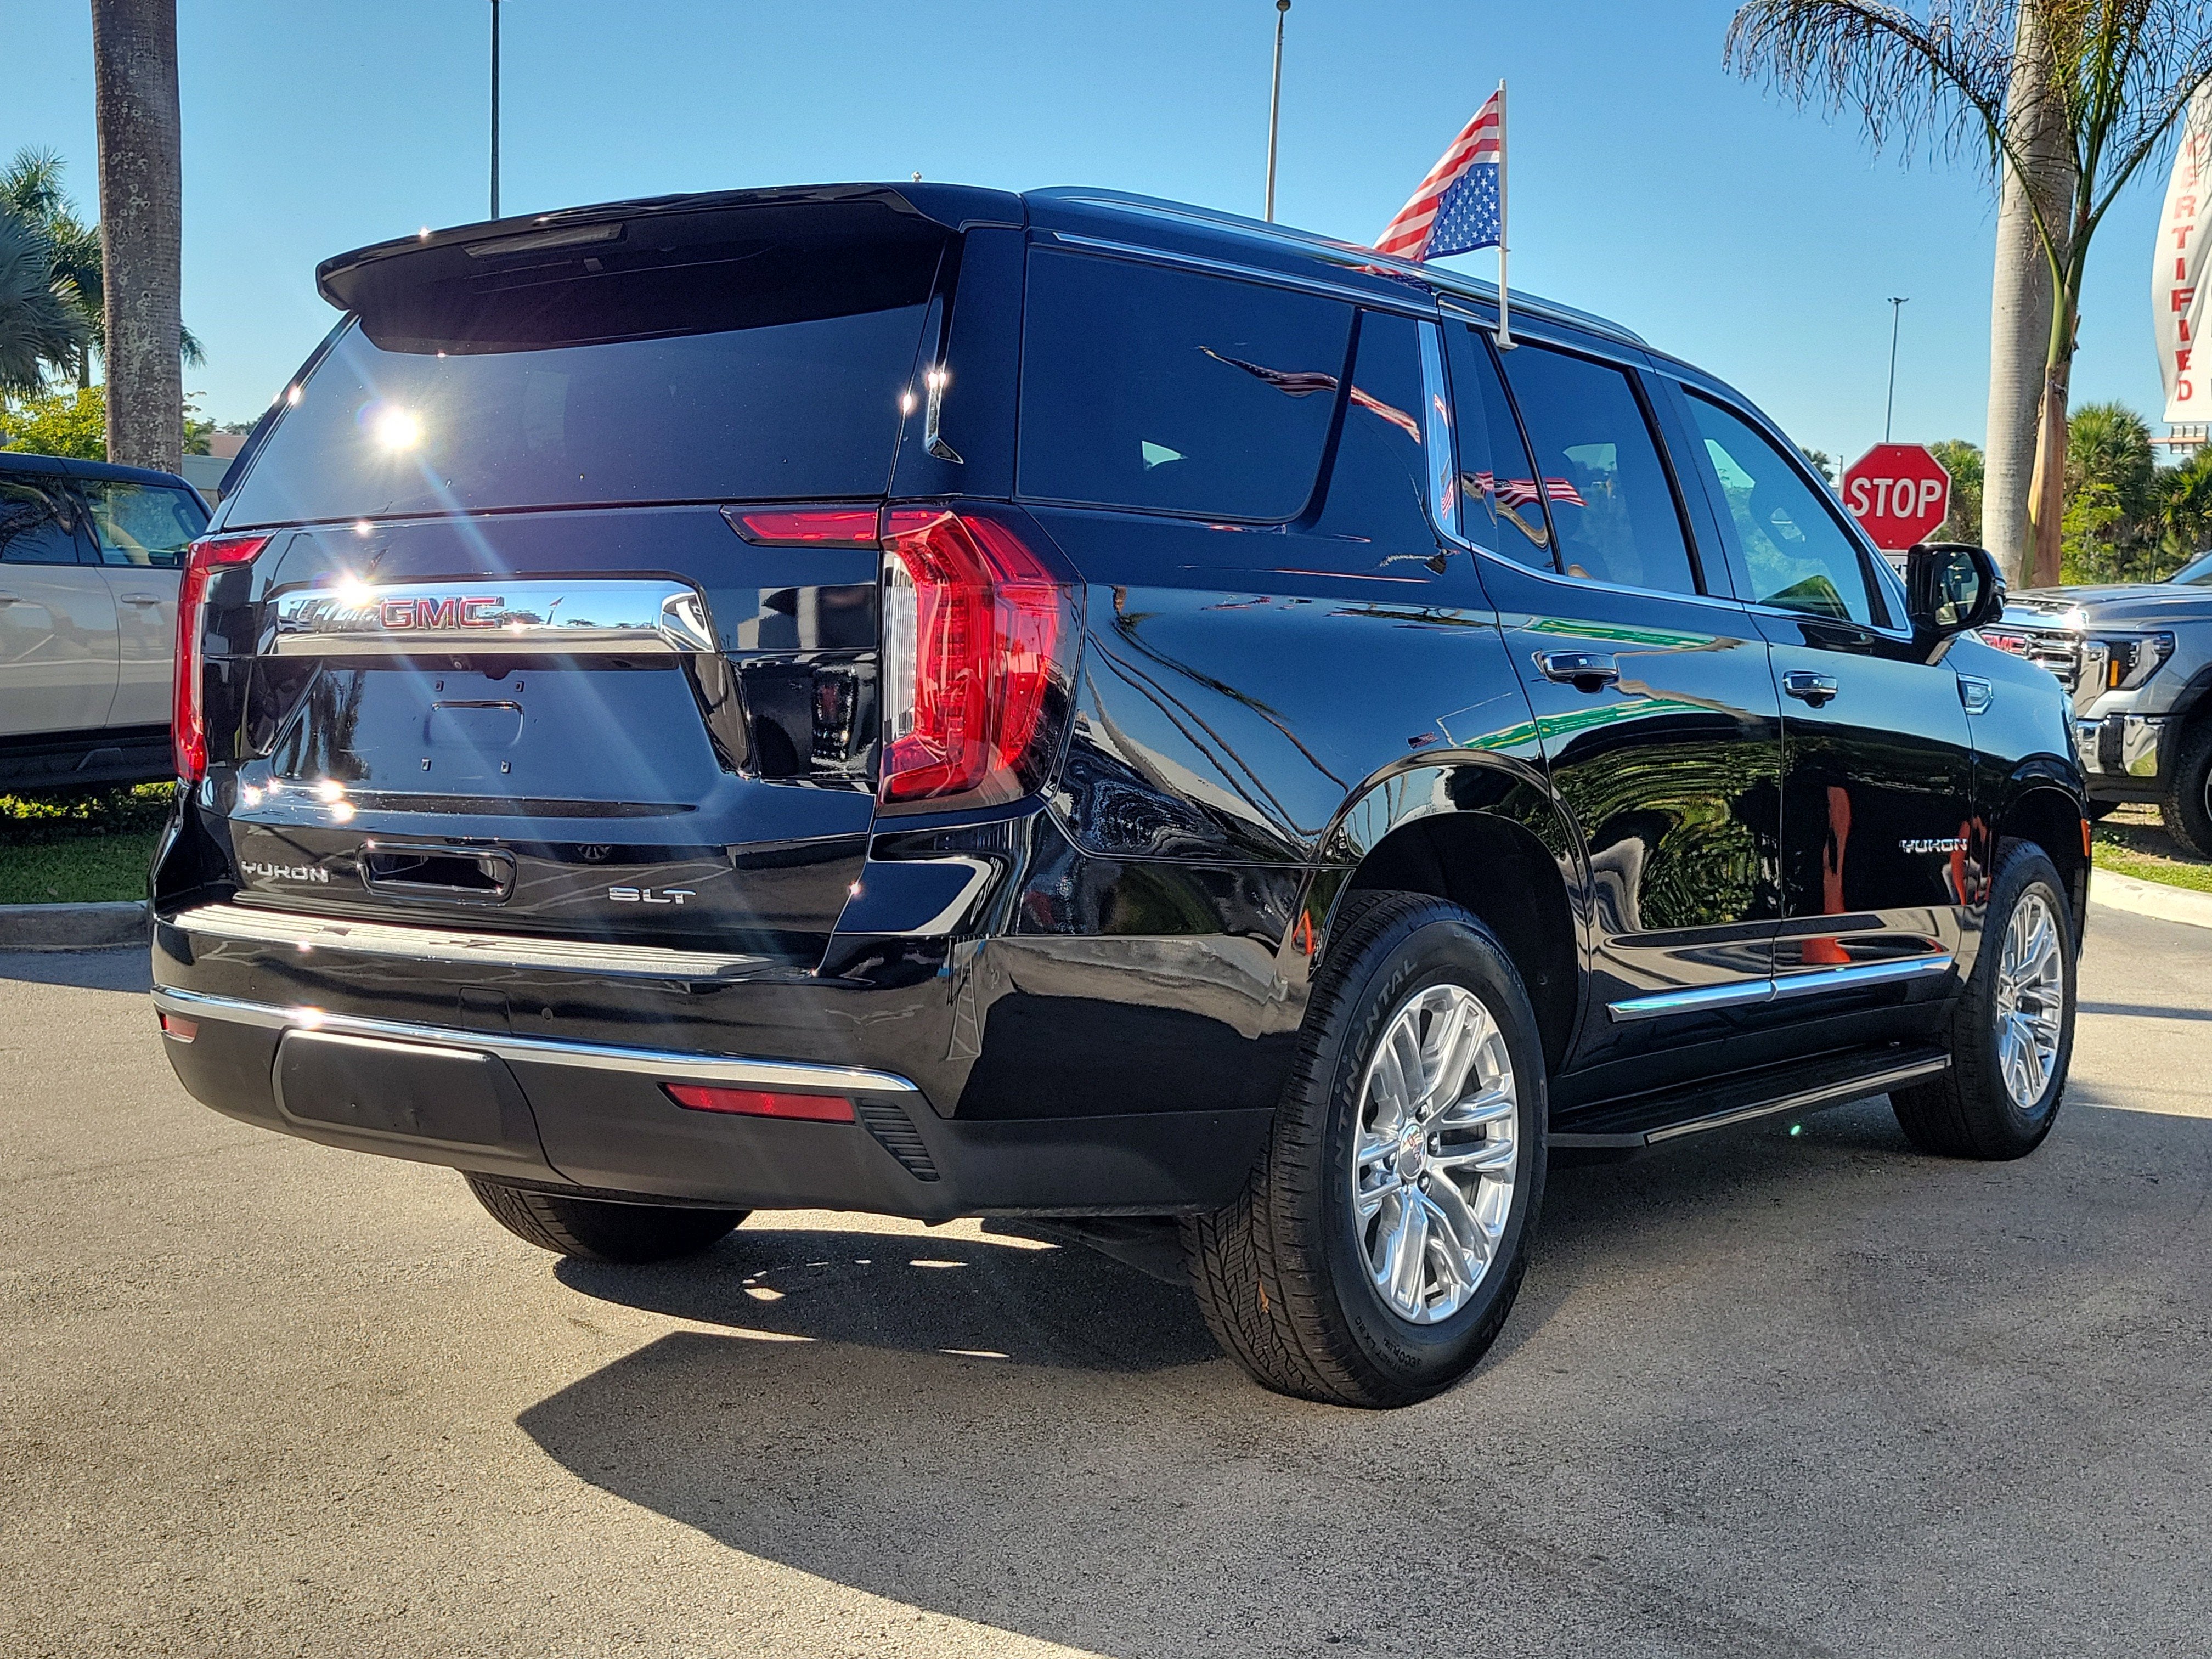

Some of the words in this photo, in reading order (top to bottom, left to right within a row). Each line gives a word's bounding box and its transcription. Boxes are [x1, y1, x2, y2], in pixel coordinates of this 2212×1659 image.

[2171, 133, 2209, 402] CERTIFIED
[1847, 478, 1942, 518] STOP
[380, 597, 503, 630] GMC
[1901, 839, 1967, 852] YUKON
[240, 862, 329, 883] YUKON
[608, 887, 696, 905] SLT
[1334, 958, 1419, 1229] ONTINENTAL
